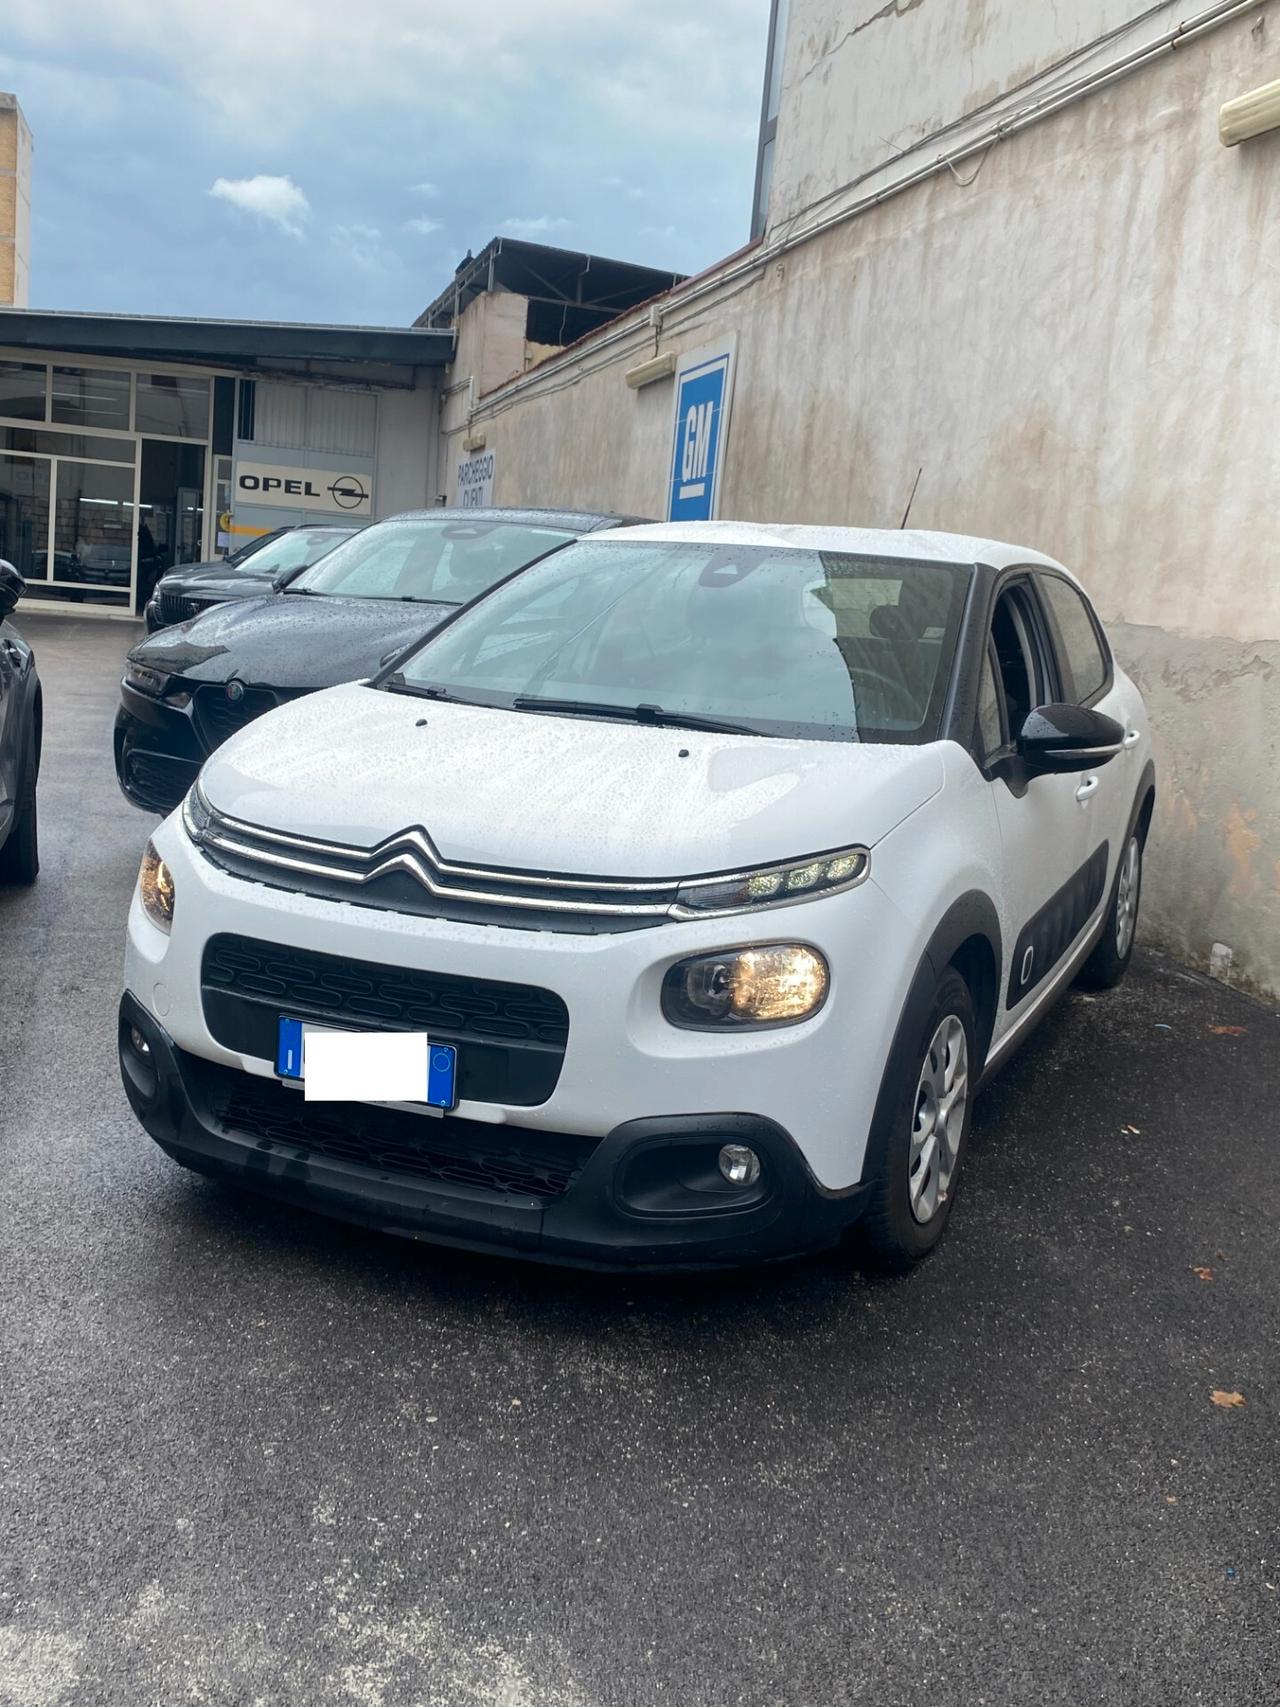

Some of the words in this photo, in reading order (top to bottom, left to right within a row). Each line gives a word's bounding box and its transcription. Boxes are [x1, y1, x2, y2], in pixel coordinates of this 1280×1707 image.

[682, 401, 714, 482] GM
[239, 475, 321, 497] OPEL
[458, 455, 493, 486] PARCHEGGIO
